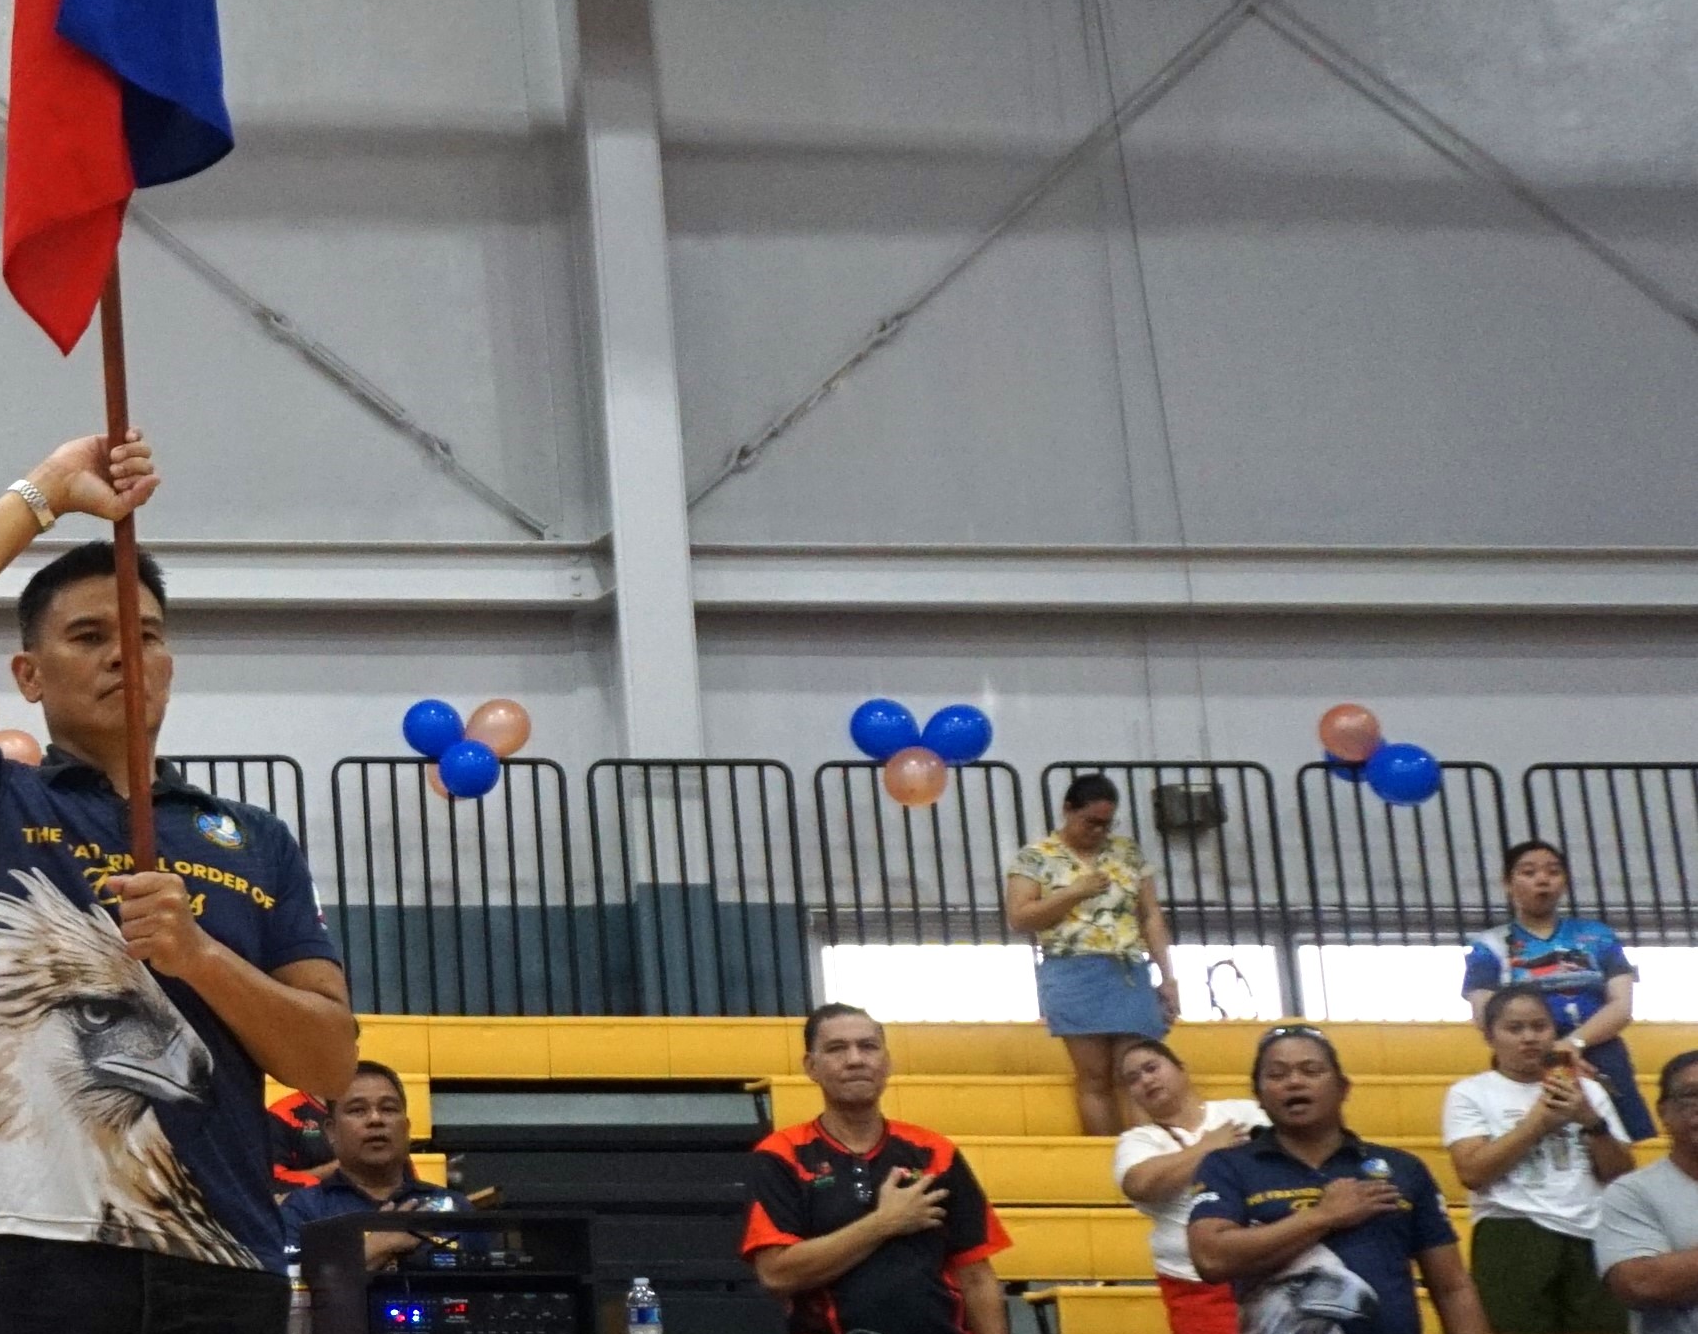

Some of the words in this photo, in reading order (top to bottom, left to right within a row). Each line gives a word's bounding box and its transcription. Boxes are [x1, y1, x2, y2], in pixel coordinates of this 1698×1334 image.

[22, 827, 63, 843] THE
[174, 861, 248, 894] ORDER
[251, 886, 276, 910] OF
